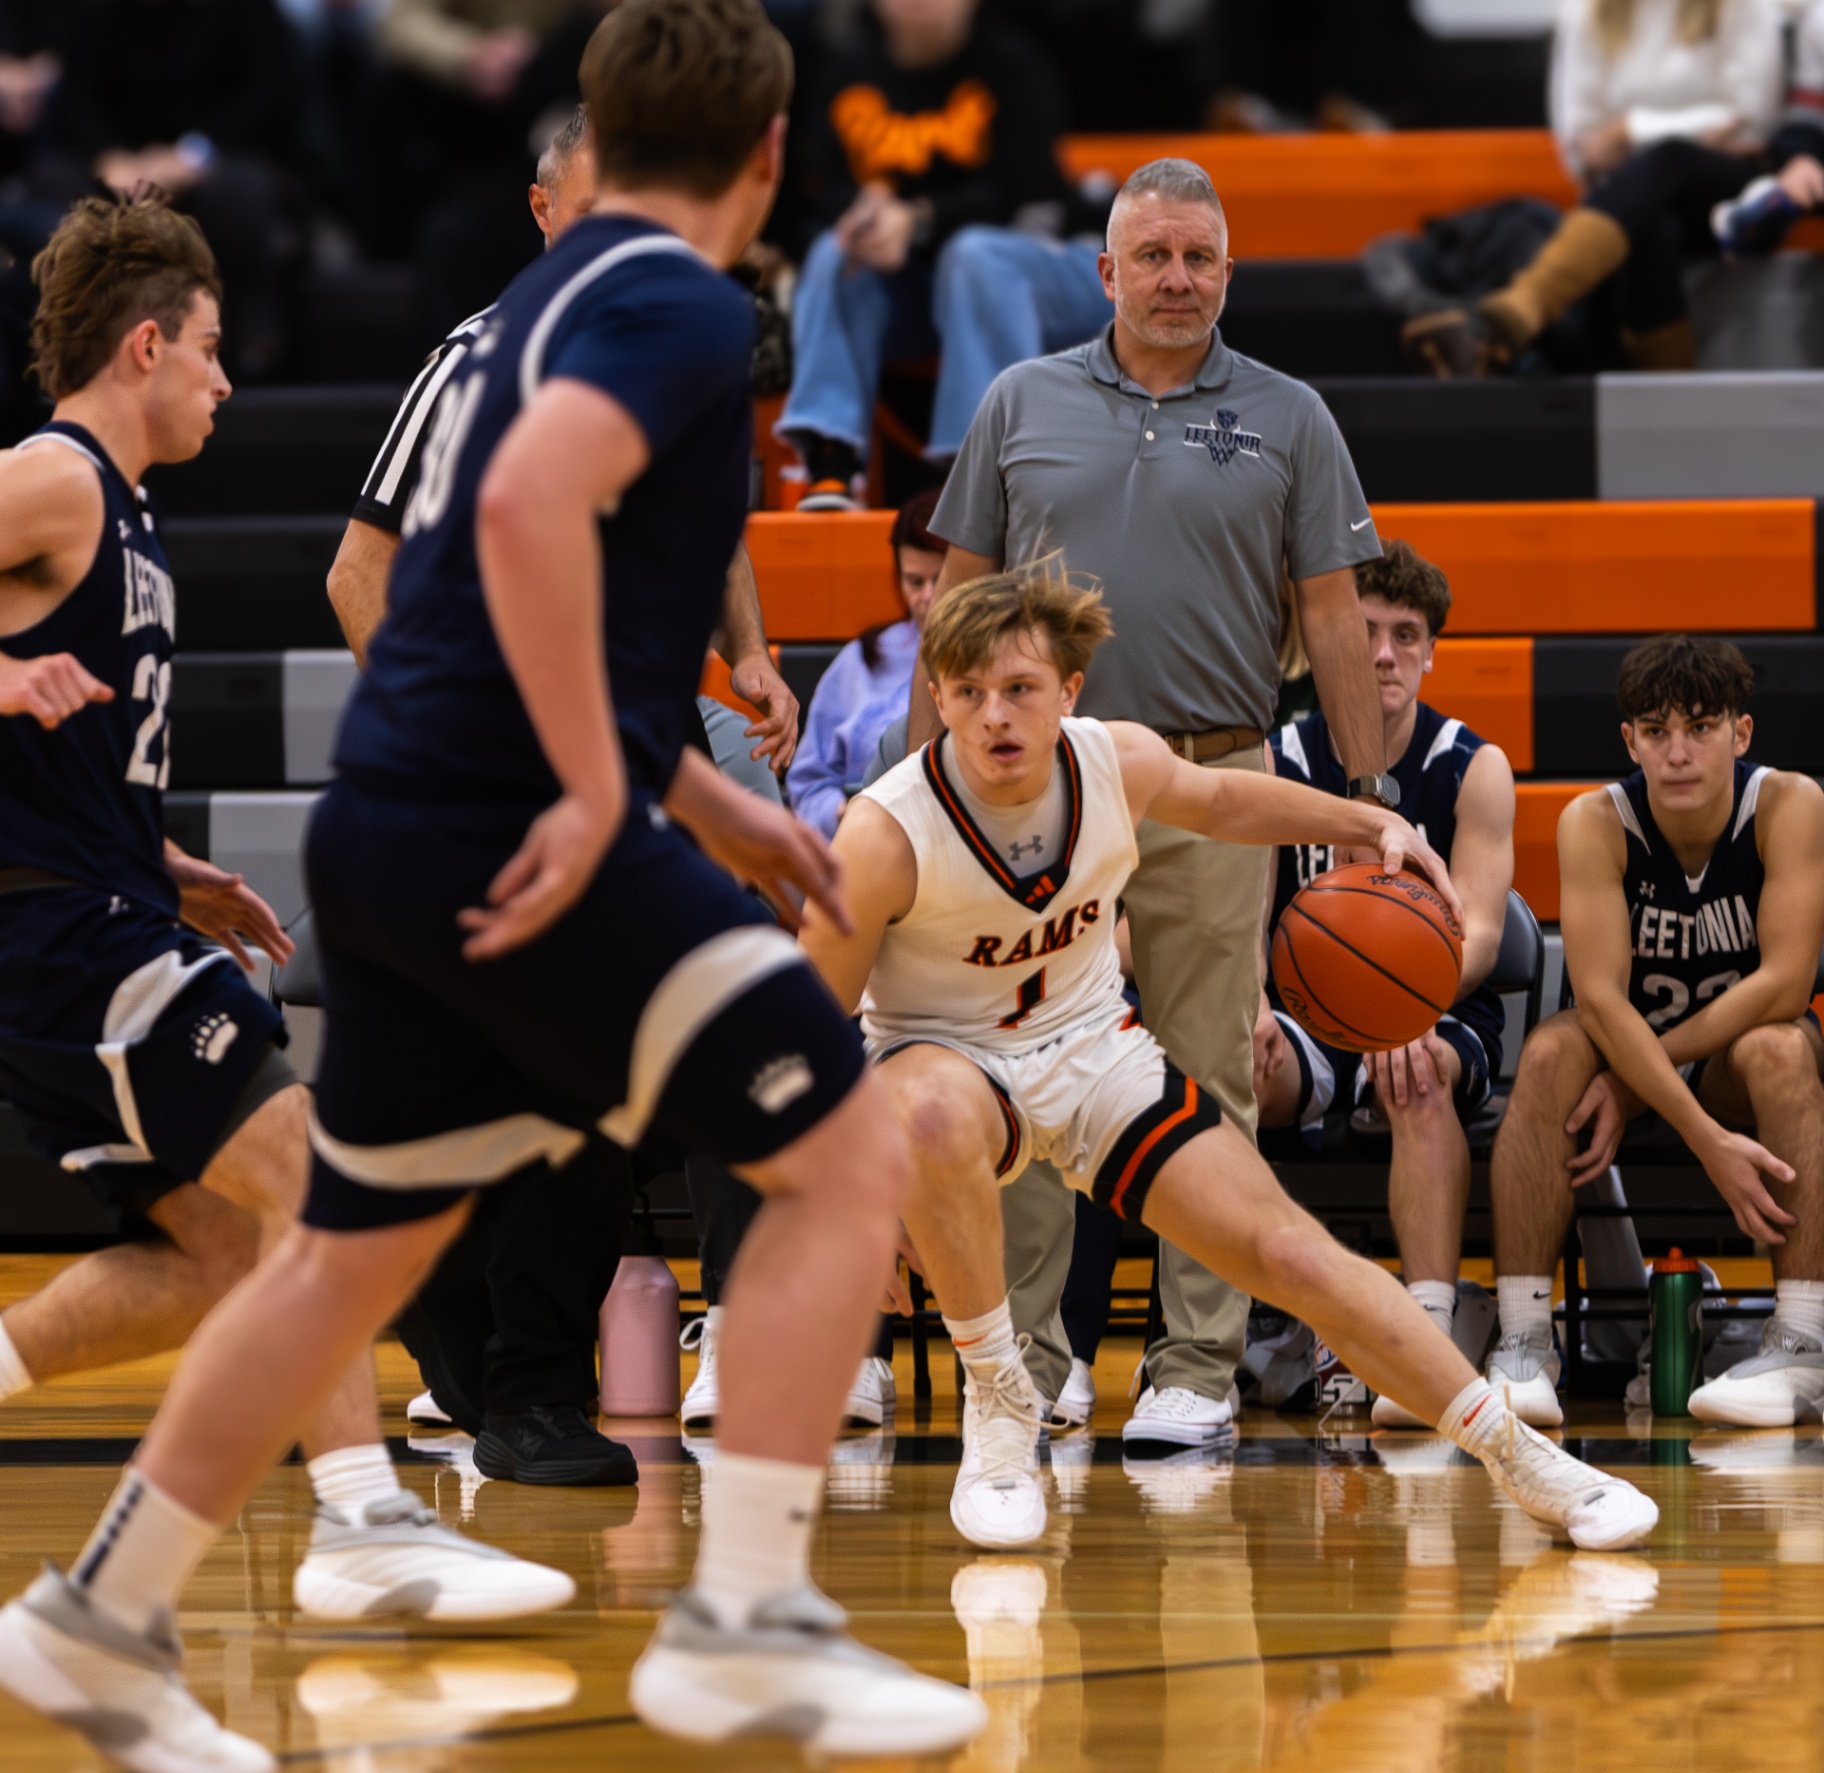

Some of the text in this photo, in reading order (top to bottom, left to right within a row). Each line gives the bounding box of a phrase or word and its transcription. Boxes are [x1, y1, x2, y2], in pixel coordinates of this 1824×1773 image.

[962, 899, 1099, 968] RAMS
[1631, 894, 1757, 960] EETONIA
[996, 965, 1047, 1029] 1
